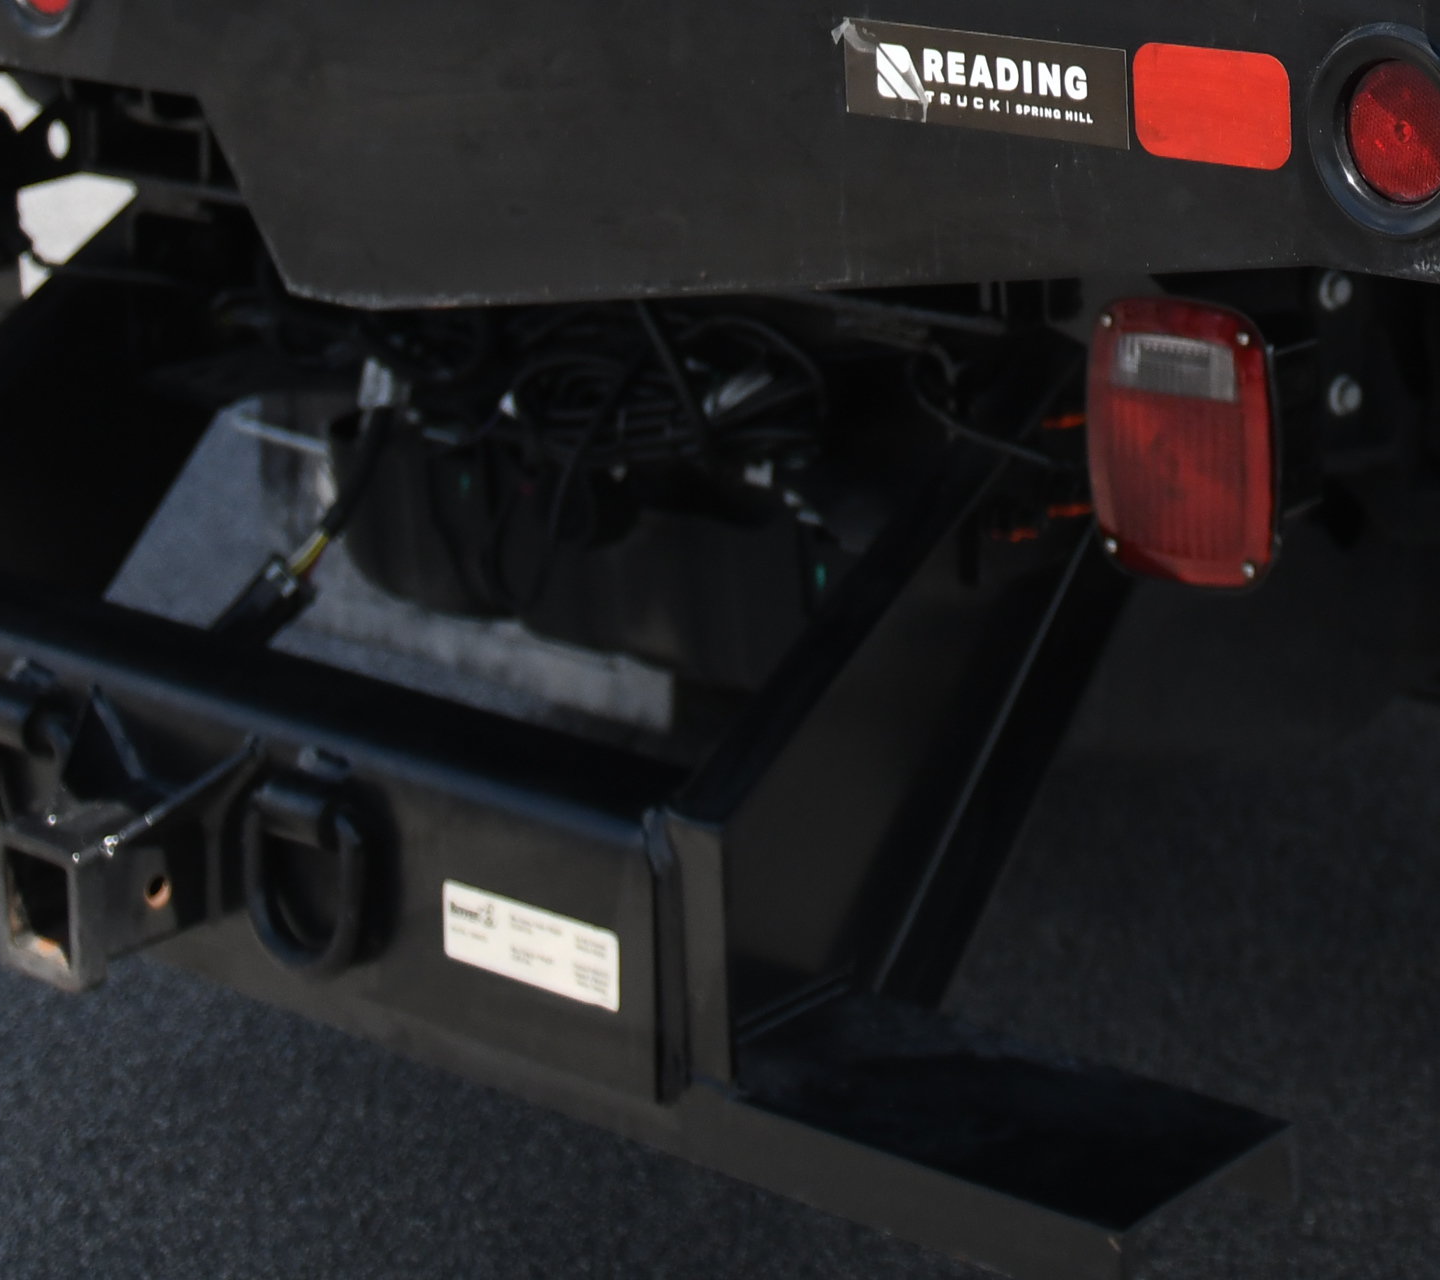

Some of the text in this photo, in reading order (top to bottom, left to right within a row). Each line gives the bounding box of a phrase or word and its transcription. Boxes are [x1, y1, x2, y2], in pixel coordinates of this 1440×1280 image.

[923, 48, 1088, 100] READING
[925, 91, 1093, 124] TRUCK SPRING HILL
